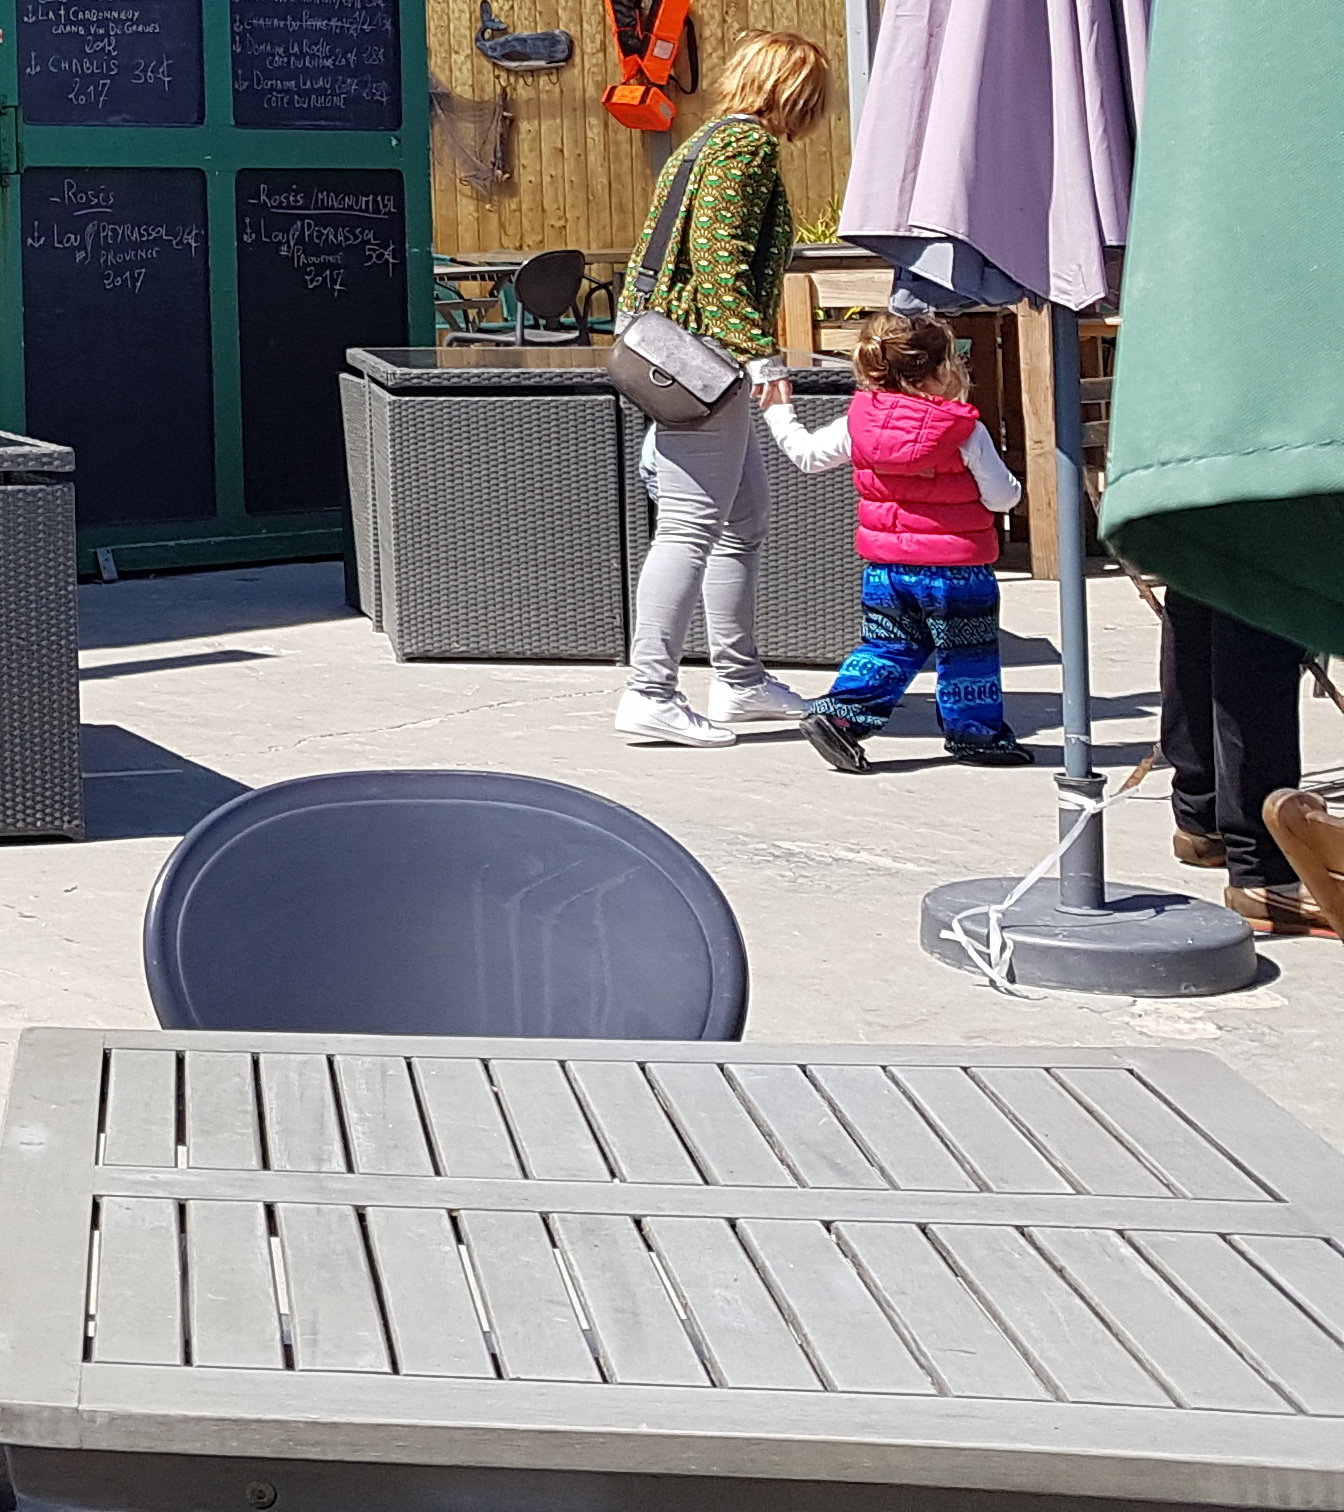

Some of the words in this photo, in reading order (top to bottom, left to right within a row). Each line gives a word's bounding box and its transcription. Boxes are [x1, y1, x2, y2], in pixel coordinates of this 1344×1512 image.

[48, 55, 119, 75] CHABLIS
[67, 77, 111, 109] 2017
[304, 219, 381, 247] PEYRASSOL
[103, 268, 146, 294] 2017
